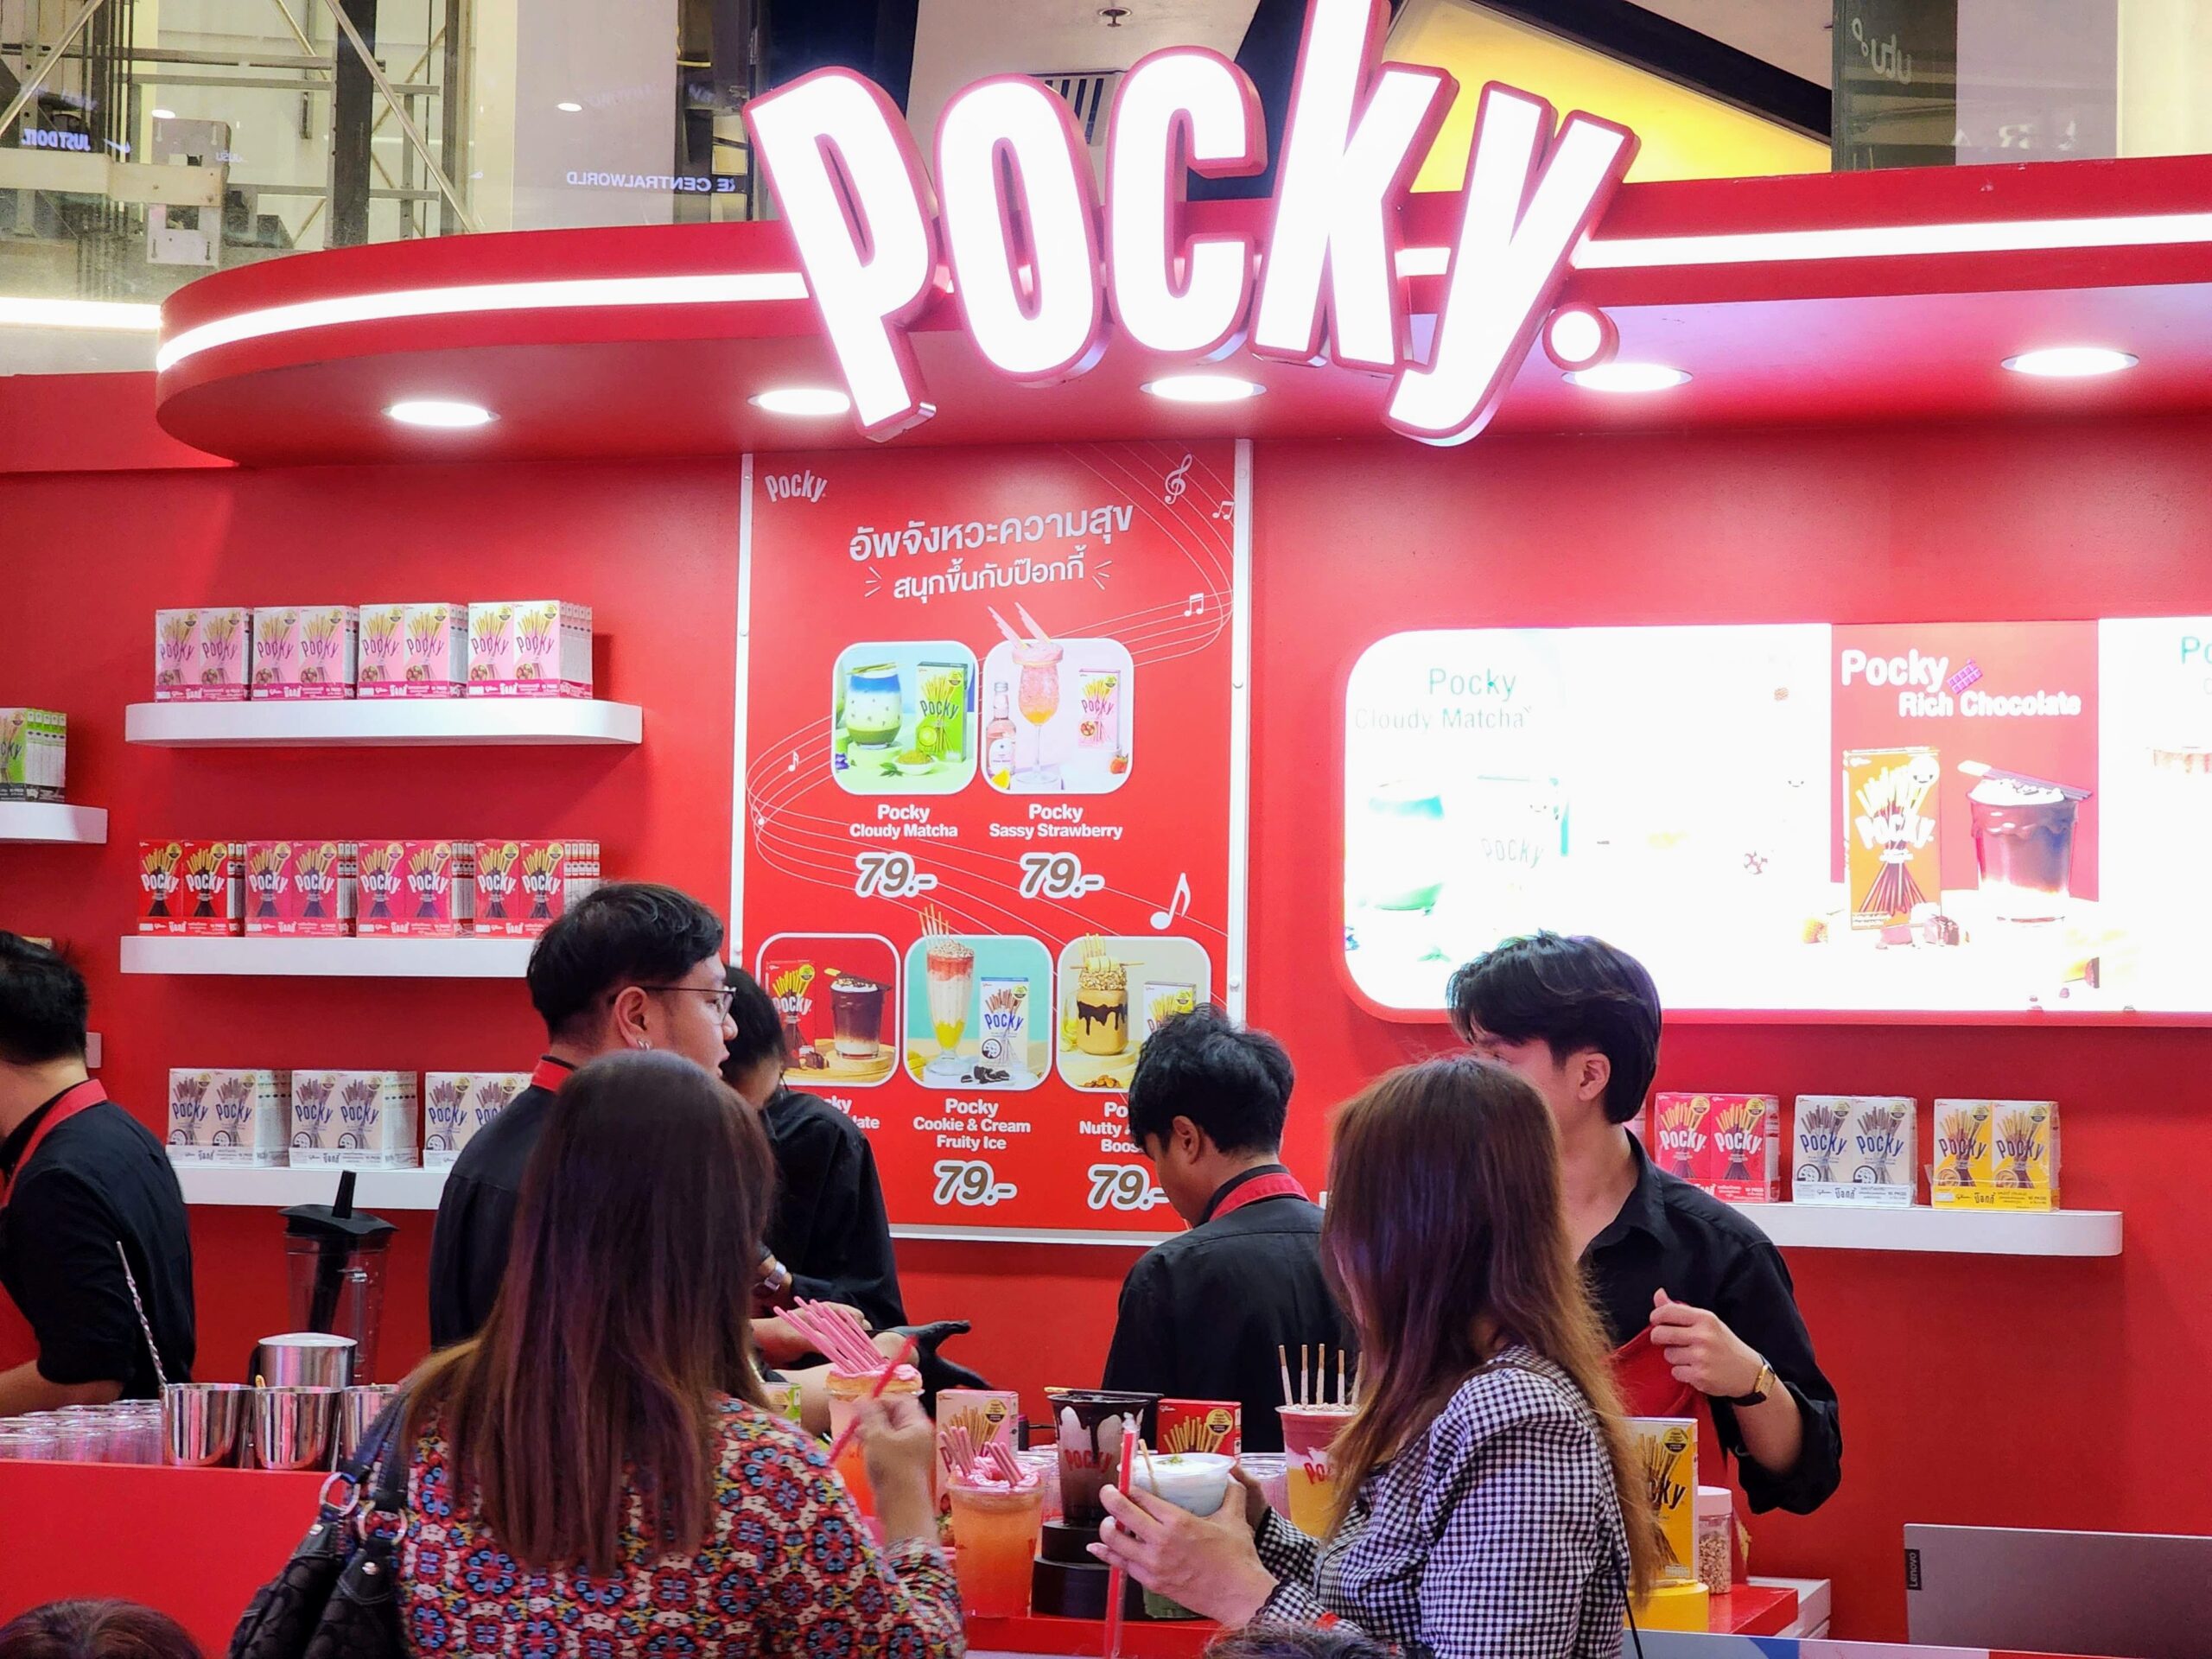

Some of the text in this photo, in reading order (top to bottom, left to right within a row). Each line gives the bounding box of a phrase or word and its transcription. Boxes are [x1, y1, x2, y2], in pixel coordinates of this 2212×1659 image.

[849, 505, 1134, 561] อัพจังหวะความสุข
[1840, 649, 1949, 693] Pocky
[1428, 668, 1516, 702] Pocky
[1898, 690, 2082, 717] Rich Chocolate
[1442, 708, 1525, 729] Matcha
[877, 804, 930, 823] Pocky
[1028, 804, 1084, 822] Pocky
[849, 823, 958, 839] Cloudy Matcha
[989, 823, 1123, 840] Sassy Strawberry
[944, 1098, 999, 1118] Pocky
[913, 1116, 1031, 1133] Cookie & Cream
[1079, 1121, 1122, 1138] Nutty
[937, 1135, 1007, 1152] Fruity Ice
[1909, 1552, 1917, 1587] Lenovo
